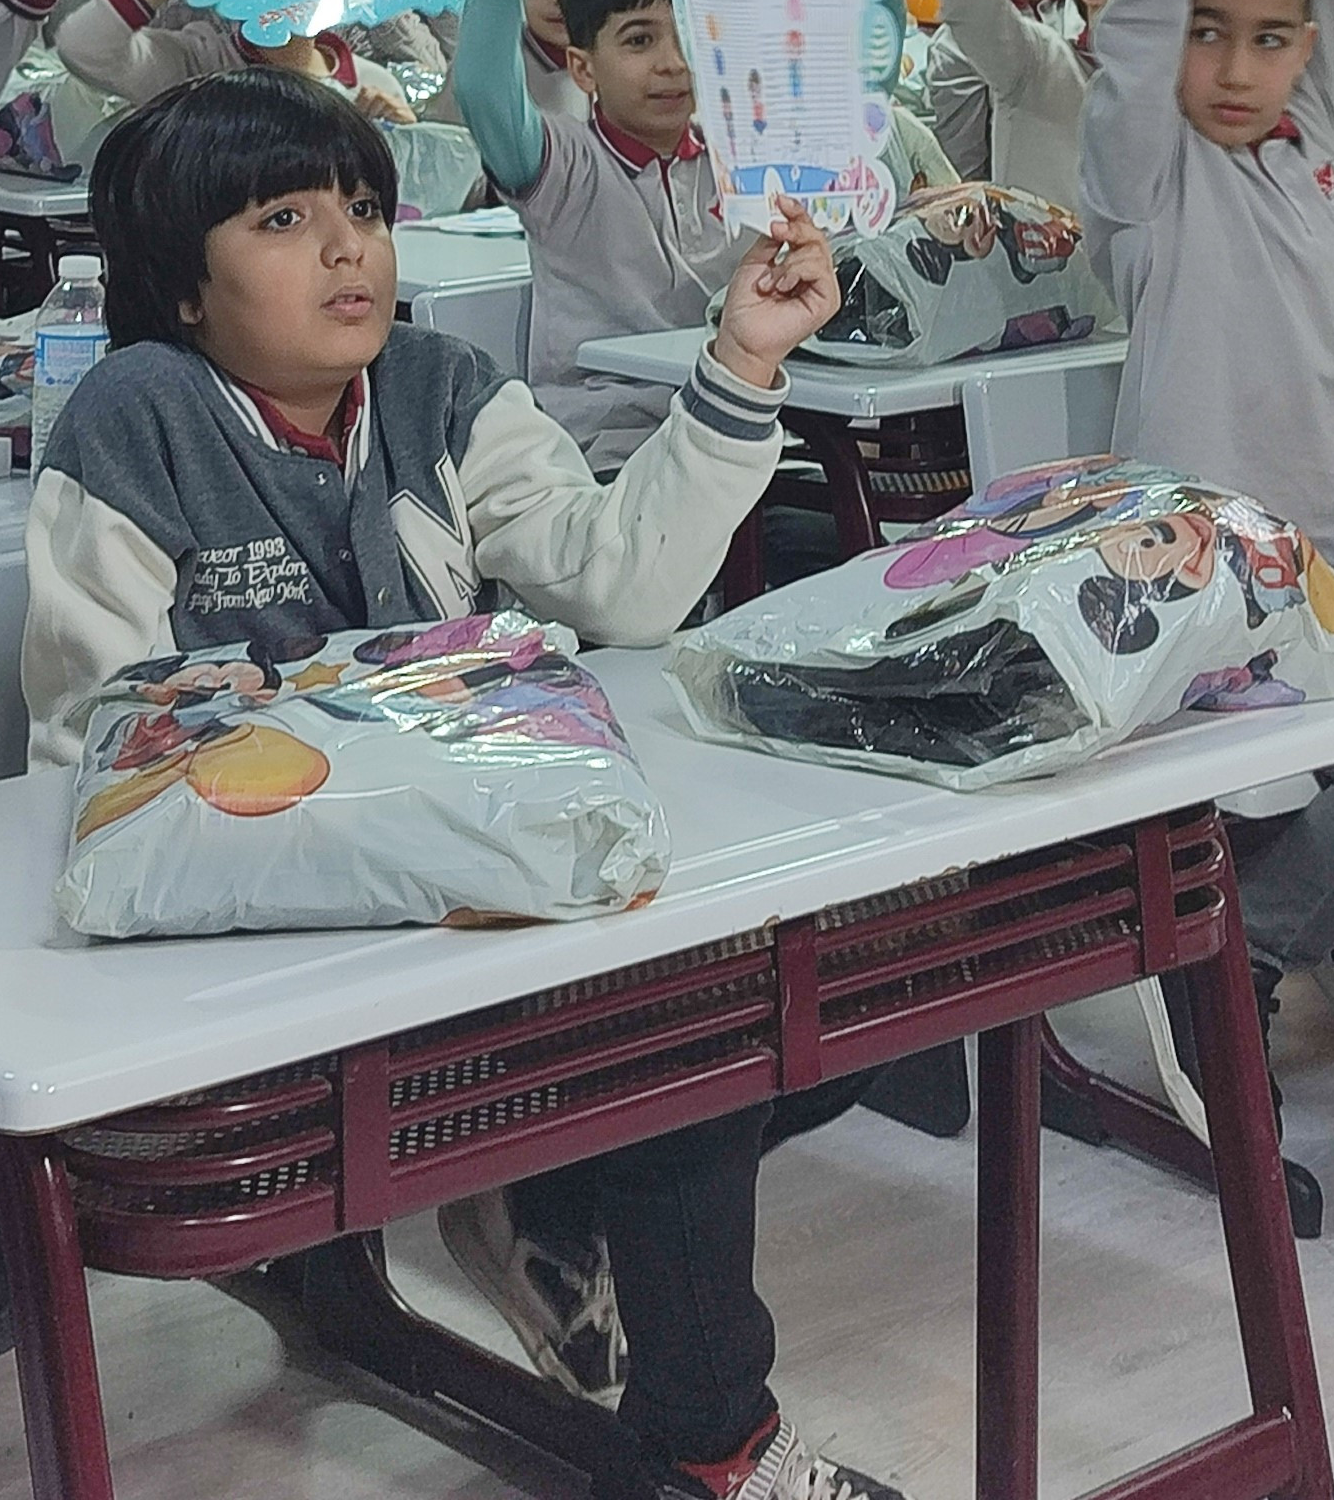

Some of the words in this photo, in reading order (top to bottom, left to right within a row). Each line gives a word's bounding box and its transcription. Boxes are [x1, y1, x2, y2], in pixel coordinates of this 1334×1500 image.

[247, 536, 286, 562] 1993
[245, 583, 275, 610] New
[276, 576, 314, 606] York
